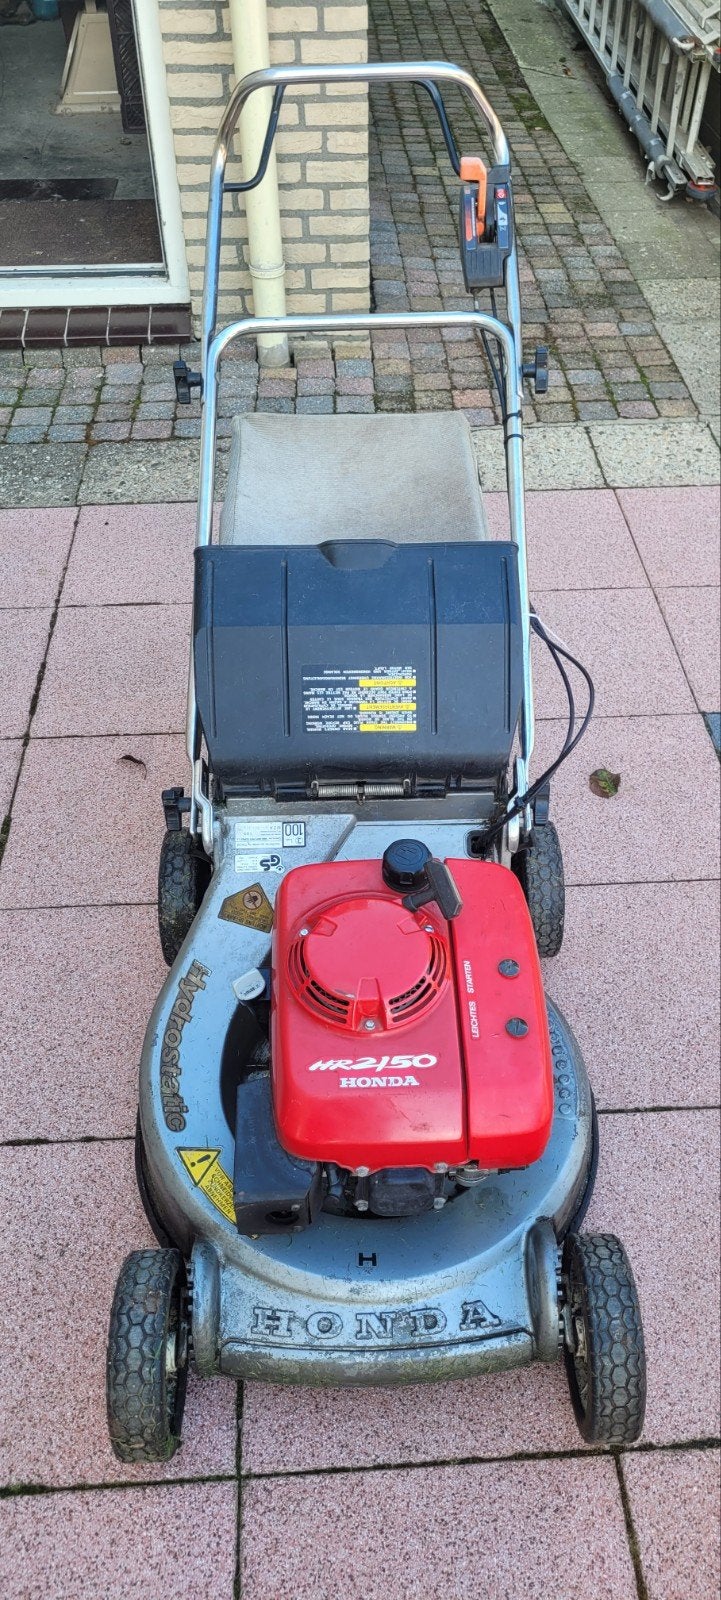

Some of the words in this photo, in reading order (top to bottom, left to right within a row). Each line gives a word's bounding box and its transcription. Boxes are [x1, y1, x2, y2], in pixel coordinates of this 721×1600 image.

[284, 824, 303, 837] 100
[259, 854, 281, 872] GS
[463, 960, 475, 994] STARTEN
[468, 1001, 480, 1039] LEICHTES
[159, 959, 212, 1133] Hydrostatic
[339, 1075, 420, 1088] HONDA
[358, 1252, 377, 1267] H
[250, 1299, 502, 1340] HONDA
